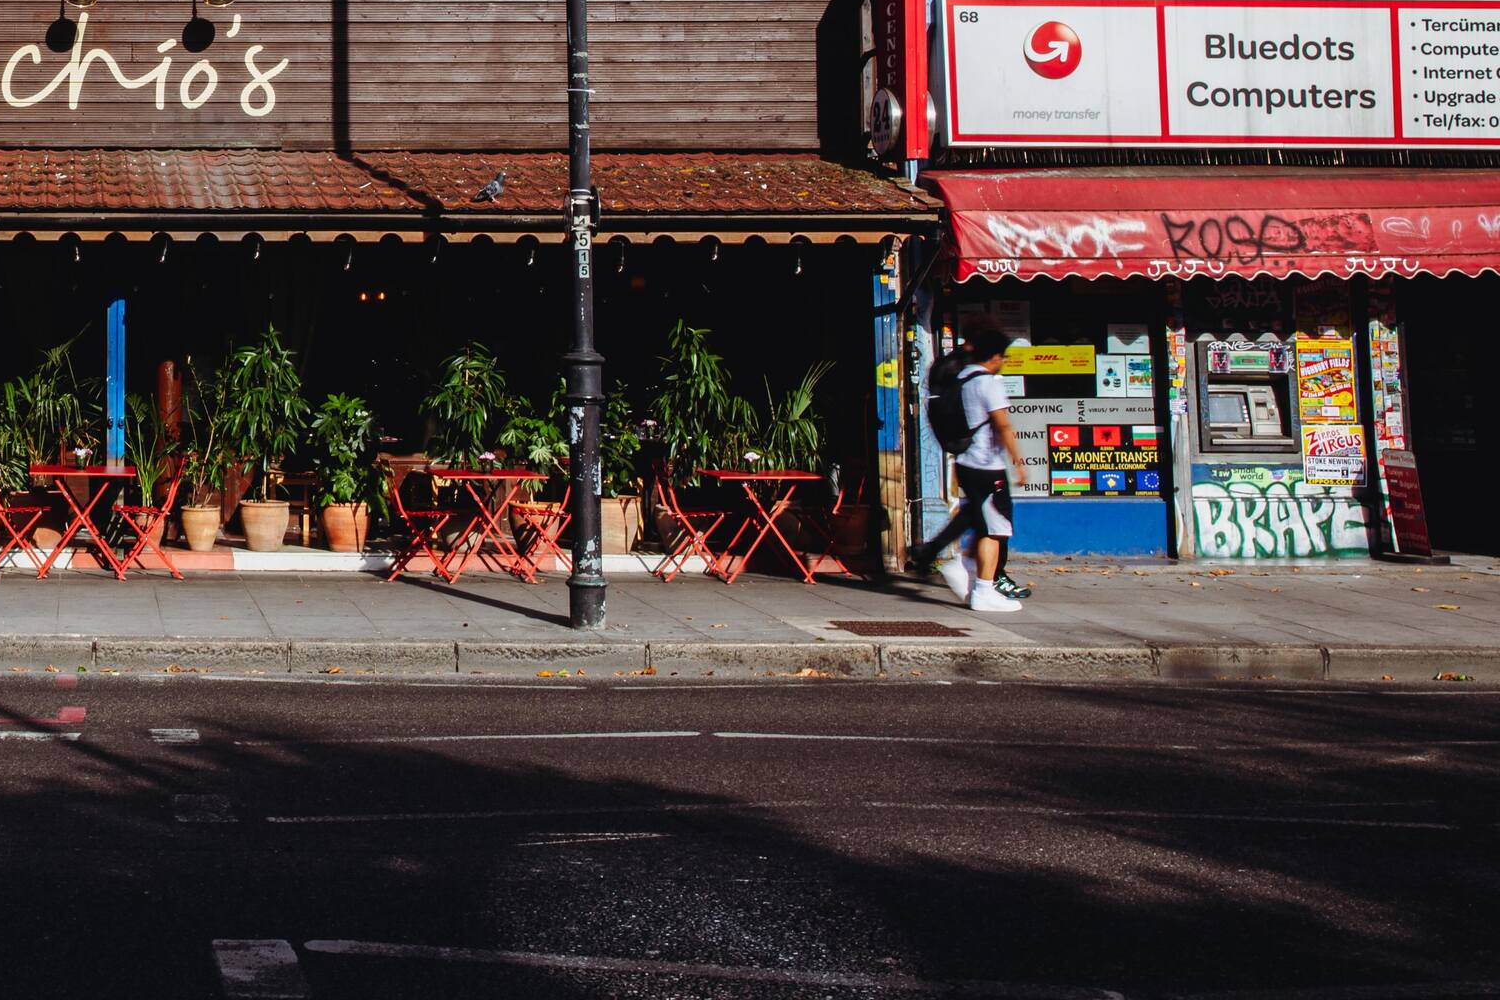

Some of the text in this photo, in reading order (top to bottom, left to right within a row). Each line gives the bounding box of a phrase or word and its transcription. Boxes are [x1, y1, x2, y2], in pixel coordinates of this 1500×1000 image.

[959, 11, 979, 23] 68
[1204, 33, 1355, 62] Bluedots
[1423, 66, 1492, 79] Internet
[1186, 81, 1376, 114] Computers
[1424, 90, 1496, 107] Upgrade
[873, 99, 890, 132] 24
[1012, 108, 1101, 122] money transfer
[1423, 113, 1485, 130] Tel/fax:
[1300, 358, 1350, 376] HIGHBURY FIELDS
[1008, 404, 1063, 414] OCOPYING
[1012, 431, 1046, 439] MINAT
[1052, 452, 1073, 463] YPS
[1075, 452, 1113, 463] MONEY
[1024, 483, 1049, 492] BIND
